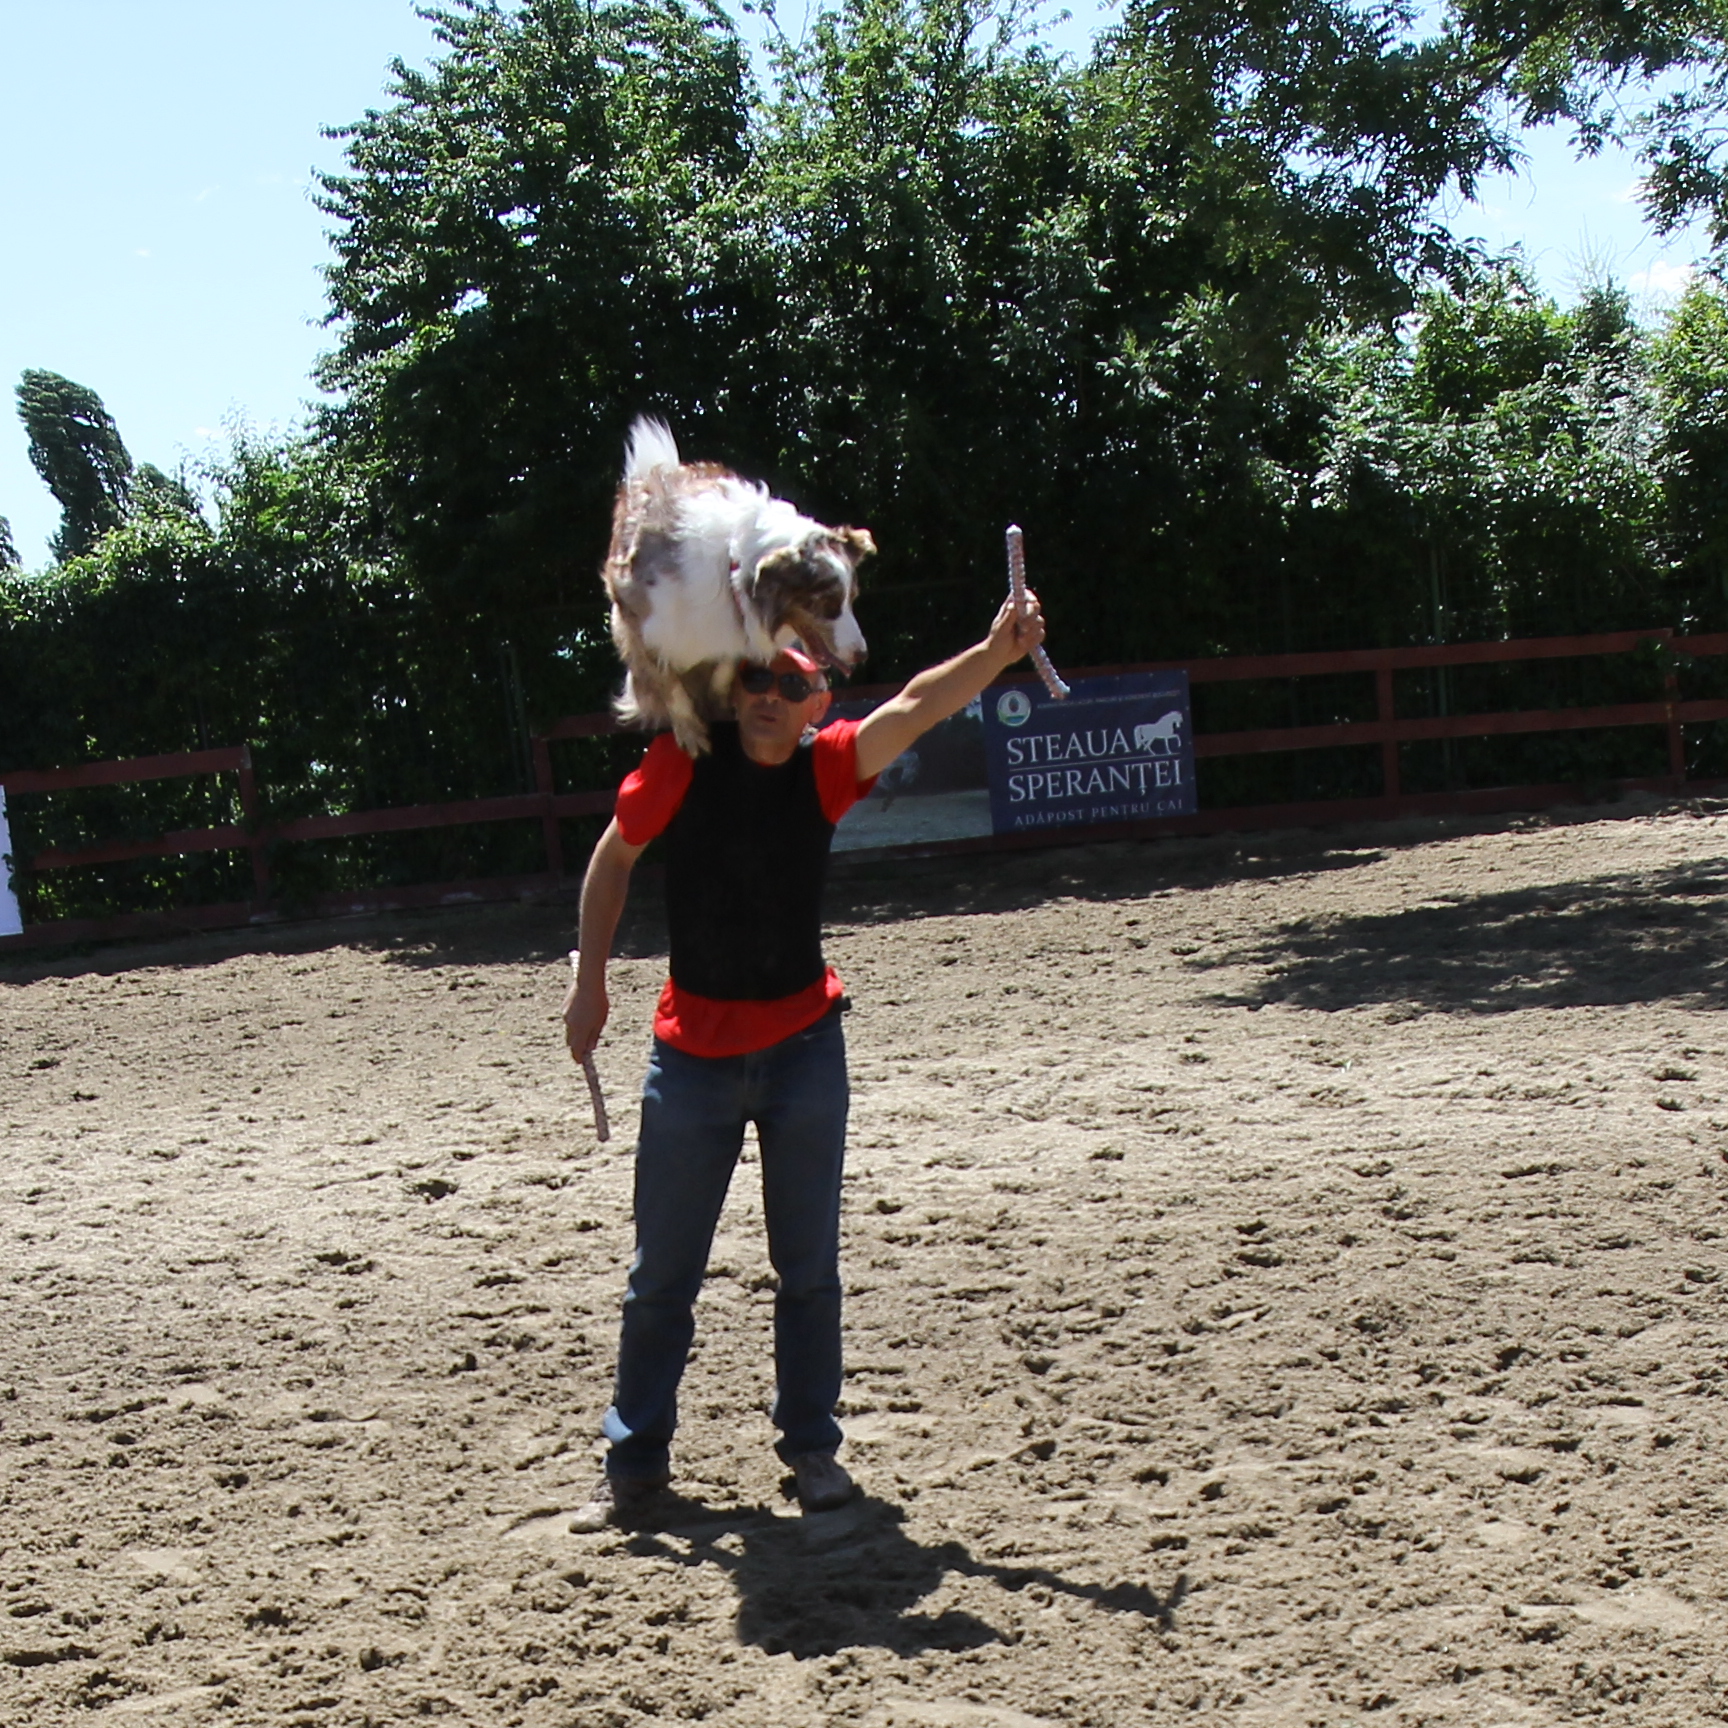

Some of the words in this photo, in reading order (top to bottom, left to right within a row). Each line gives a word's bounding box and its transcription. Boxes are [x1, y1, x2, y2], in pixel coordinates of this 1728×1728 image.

[1007, 728, 1131, 764] STEAUA
[1092, 803, 1149, 817] PENTRU
[1157, 799, 1182, 811] CAI
